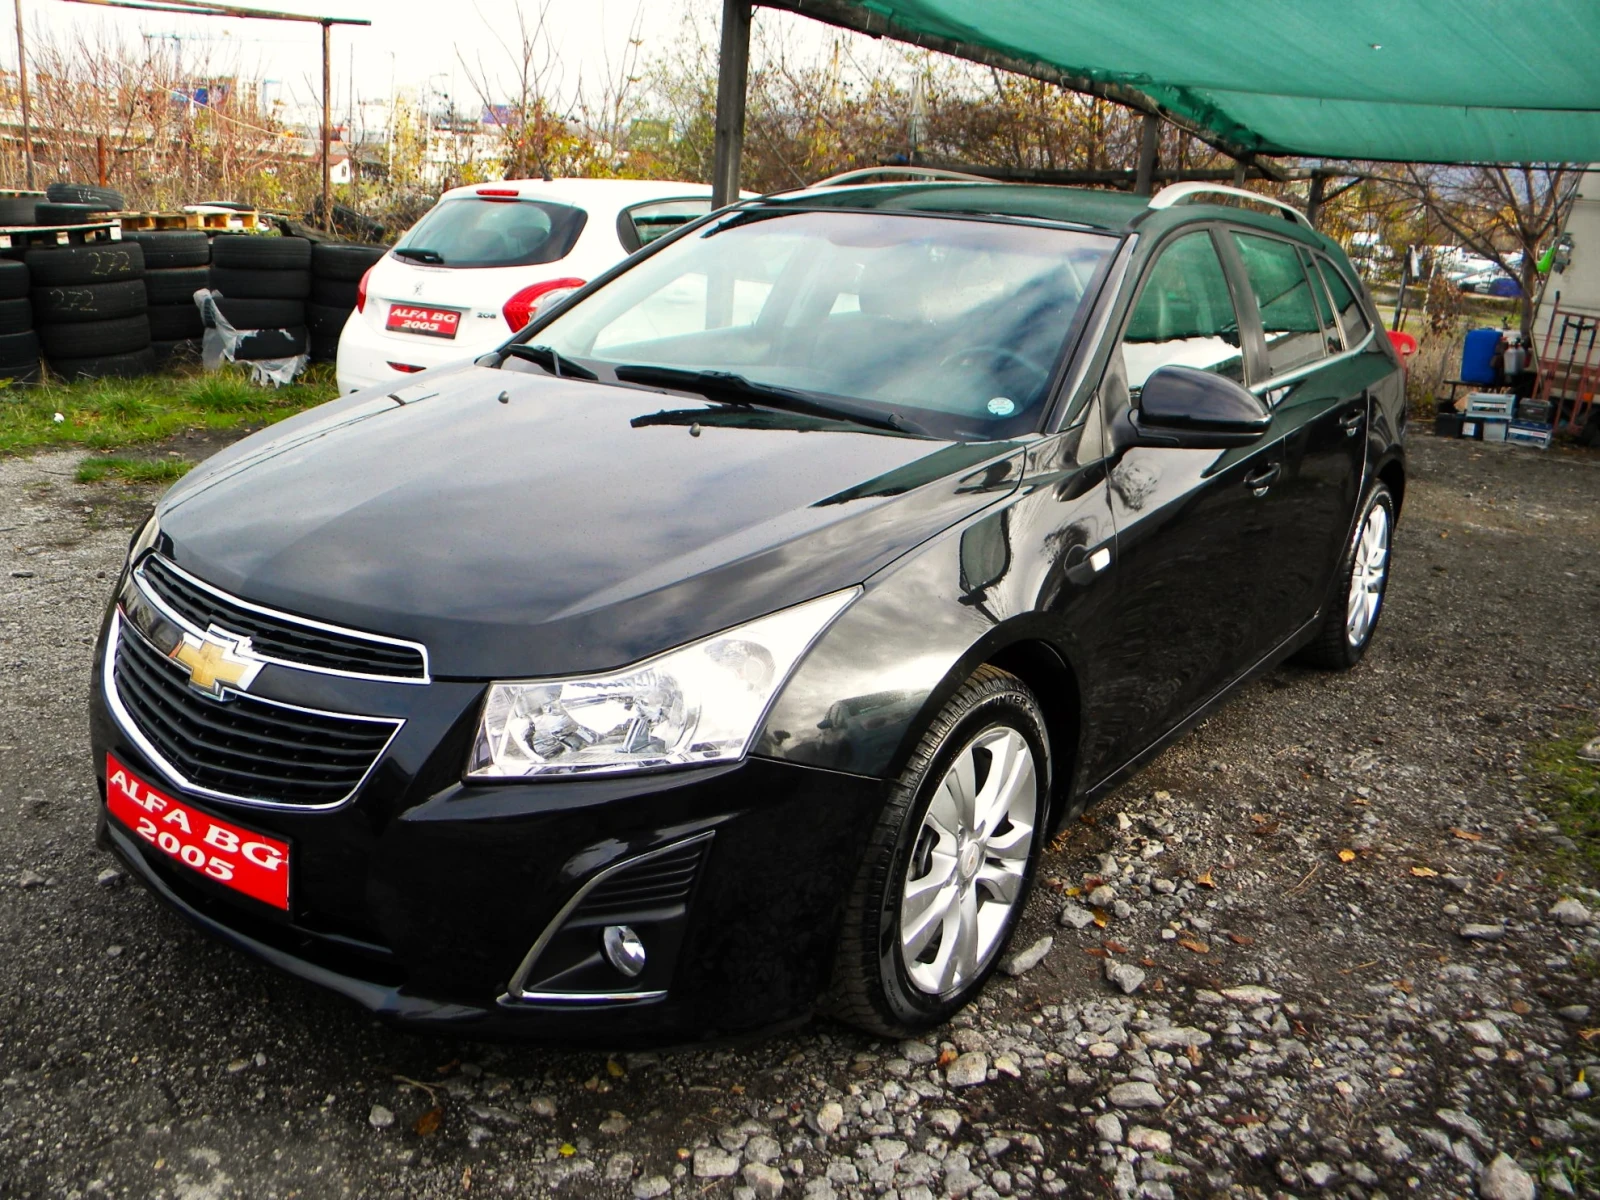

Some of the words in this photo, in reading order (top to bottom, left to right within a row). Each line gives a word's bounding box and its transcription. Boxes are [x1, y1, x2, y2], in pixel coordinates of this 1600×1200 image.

[391, 308, 428, 320] ALFA
[430, 312, 457, 324] BG
[401, 319, 440, 331] 2005
[109, 769, 193, 835] ALFA
[202, 823, 284, 872] BG
[136, 816, 236, 881] 2005
